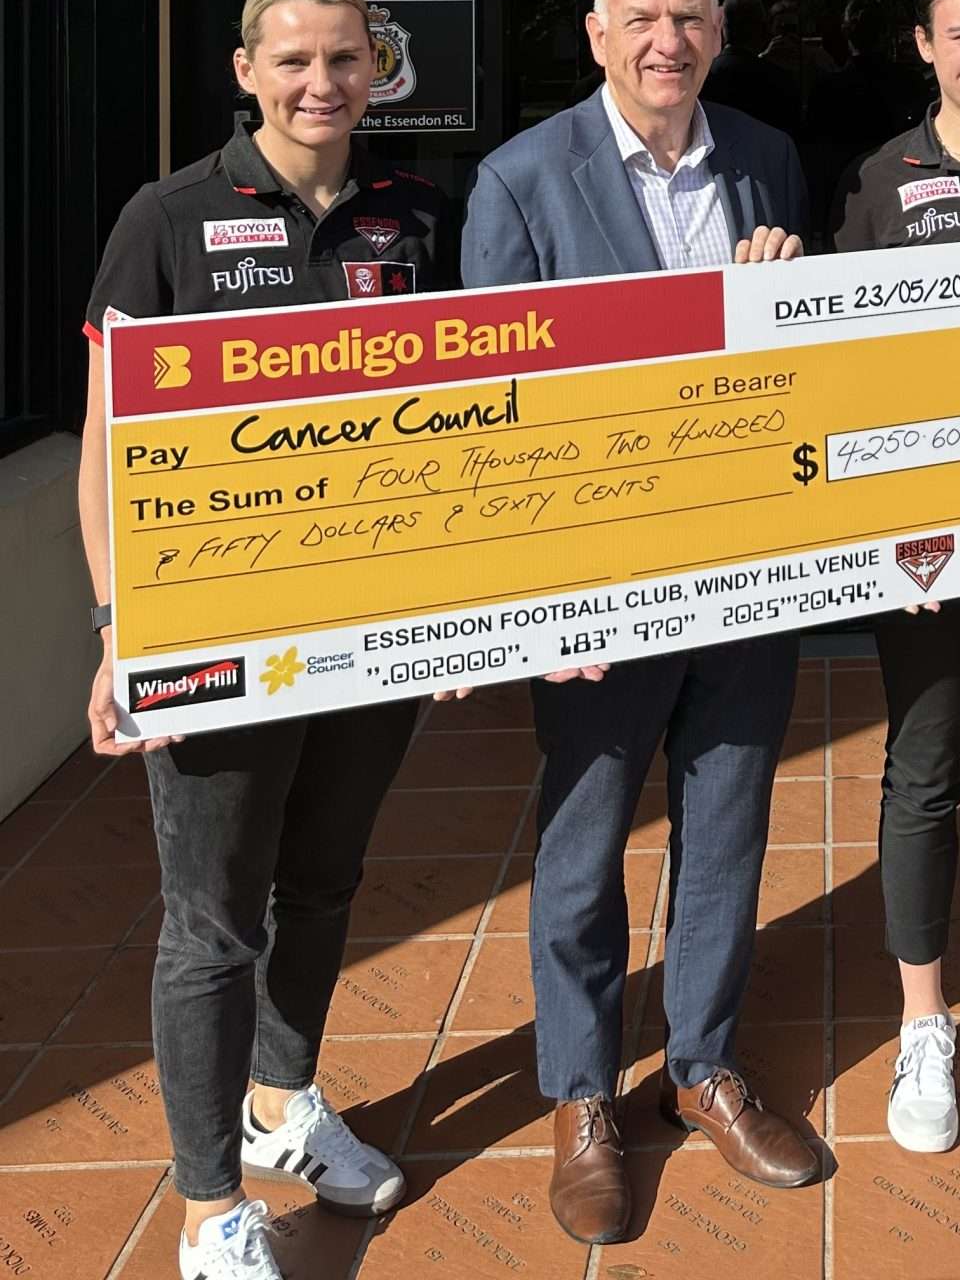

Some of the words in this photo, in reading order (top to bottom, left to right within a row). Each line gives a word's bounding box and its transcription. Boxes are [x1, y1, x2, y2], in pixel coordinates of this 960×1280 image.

[362, 117, 381, 127] the
[385, 115, 441, 126] Essendon
[445, 115, 466, 125] RSL
[914, 180, 957, 193] TOYOTA
[214, 234, 281, 245] FORKLIFTS
[228, 223, 282, 234] TOYOTA
[212, 258, 293, 294] FUJITSU
[774, 295, 843, 320] DATE
[222, 327, 423, 383] Bendigo
[435, 312, 555, 360] Bank
[679, 384, 704, 400] or
[714, 371, 797, 395] Bearer
[231, 416, 381, 455] Cancer
[393, 379, 518, 432] Council
[125, 444, 189, 470] Pay
[354, 458, 440, 498] FOUR
[461, 440, 580, 497] THOUSAND
[606, 431, 650, 459] TWO
[668, 409, 785, 449] HUNDRED
[792, 443, 819, 485] $
[131, 497, 195, 521] The
[209, 488, 283, 512] Sum
[296, 478, 328, 500] of
[189, 530, 282, 568] FIFTY
[301, 511, 422, 549] DOLLARS
[480, 491, 555, 524] SIXTY
[574, 476, 660, 504] CENTS
[897, 536, 953, 559] ESSENDON
[364, 618, 492, 651] ESSENDON
[501, 595, 619, 631] FOOTBALL
[625, 584, 688, 618] CLUB,
[694, 570, 763, 597] WINDY
[766, 562, 810, 584] HILL
[815, 549, 880, 576] VENUE
[307, 652, 354, 666] Cancer
[307, 660, 354, 675] Council
[136, 678, 198, 699] Windy
[205, 668, 237, 688] Hill
